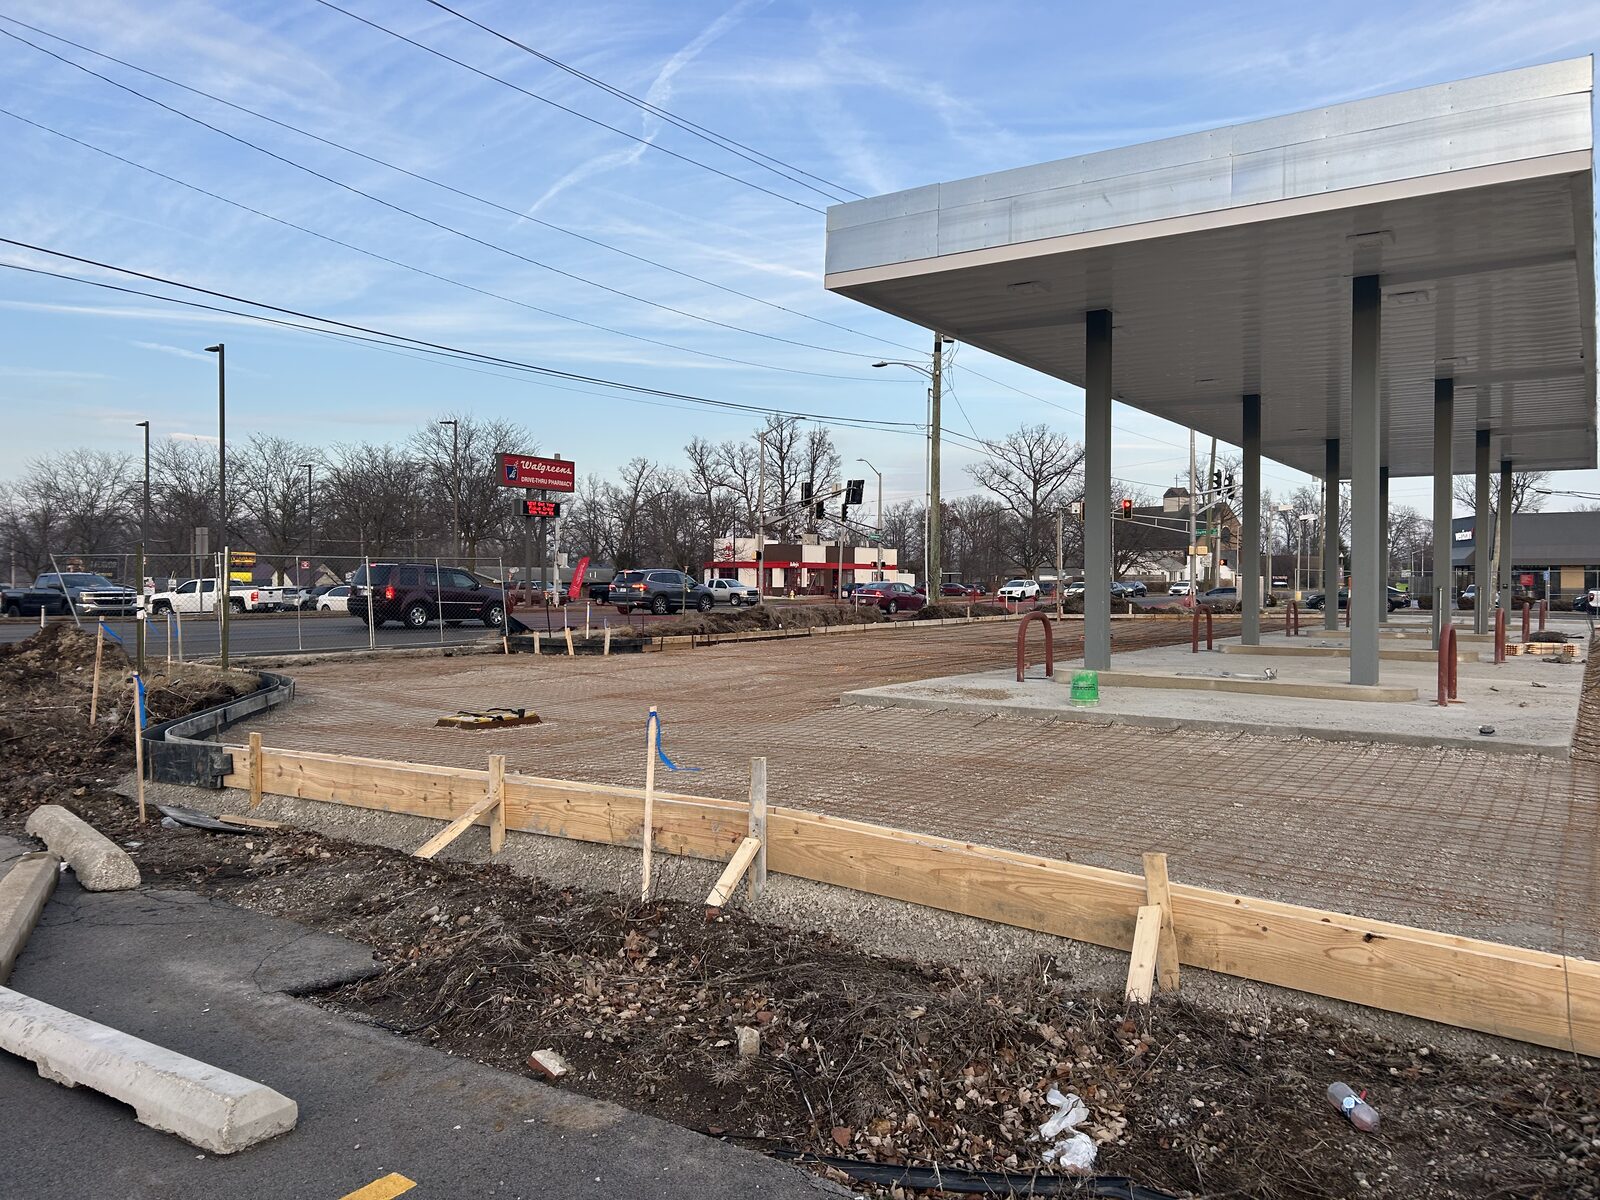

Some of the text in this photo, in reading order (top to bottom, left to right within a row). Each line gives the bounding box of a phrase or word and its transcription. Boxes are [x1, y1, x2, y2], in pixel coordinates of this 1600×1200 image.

[521, 460, 572, 474] Walgreens
[521, 476, 573, 487] DRIVE-THRU PHARMACY
